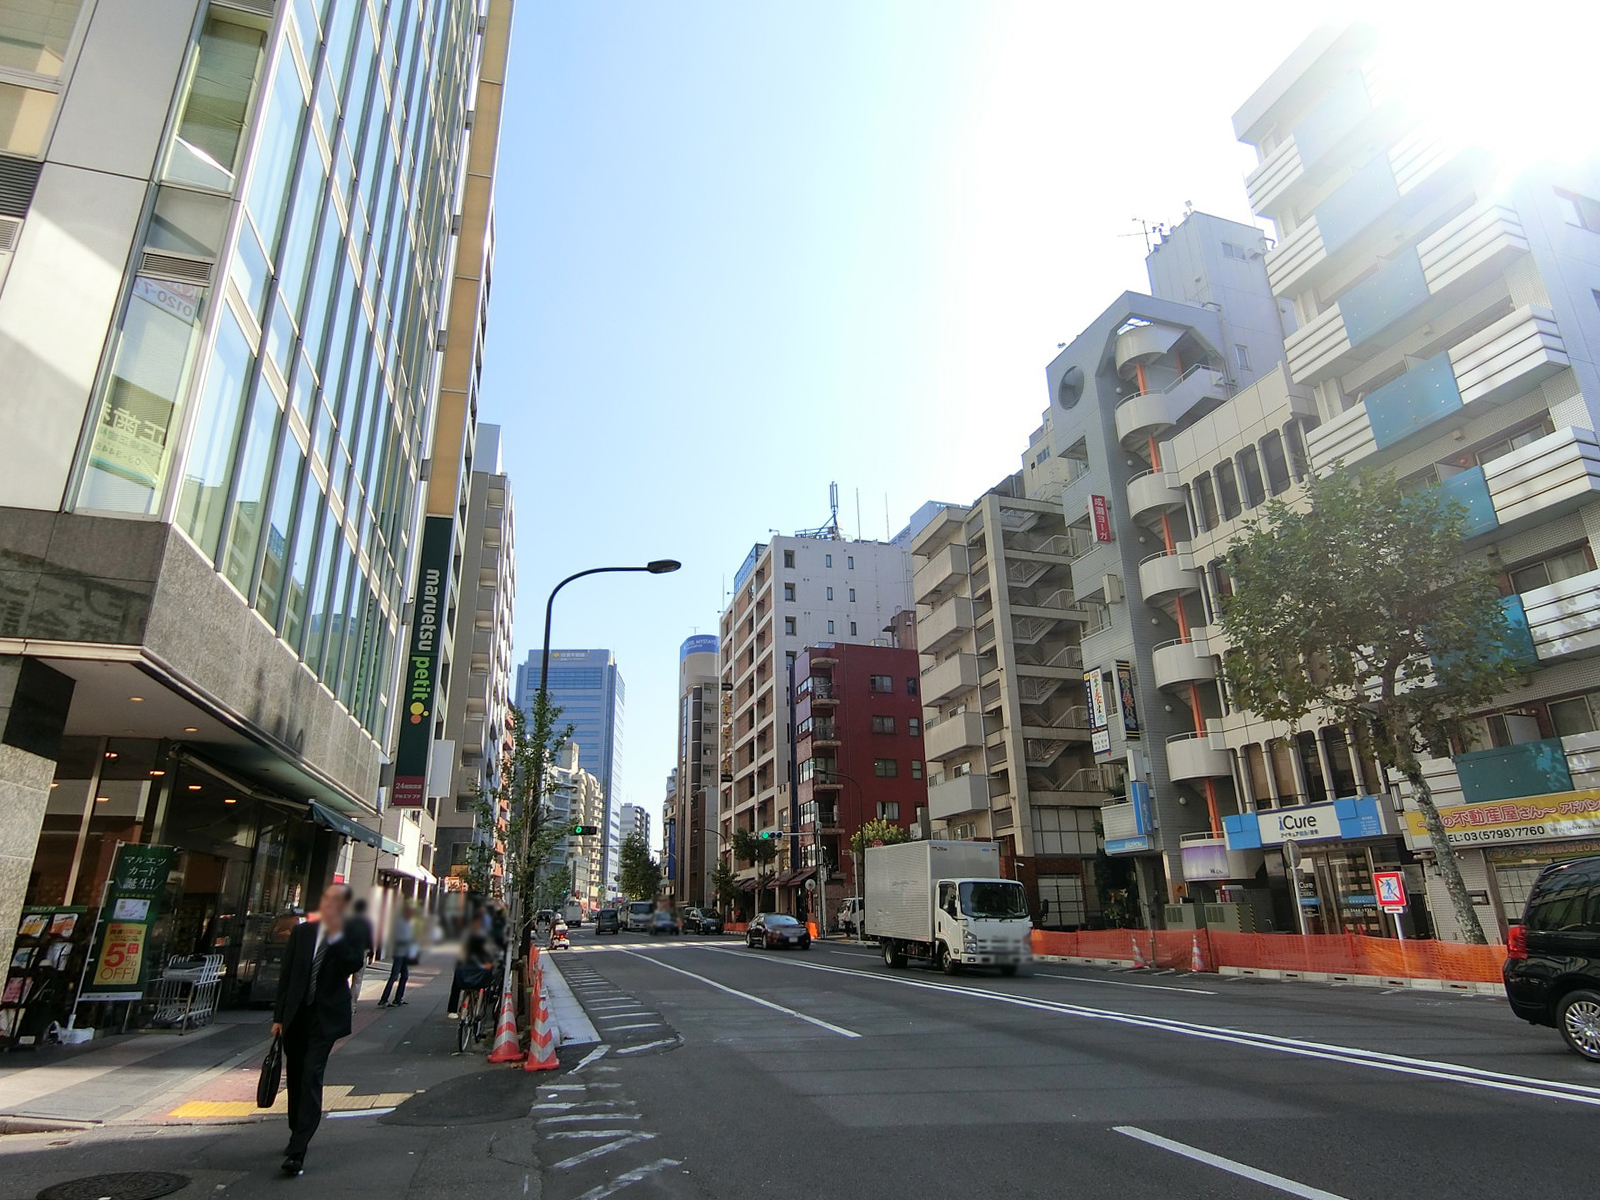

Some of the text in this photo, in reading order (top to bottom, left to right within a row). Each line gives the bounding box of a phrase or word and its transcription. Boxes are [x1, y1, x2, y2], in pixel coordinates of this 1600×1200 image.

[411, 569, 441, 700] maruetsu petit
[1278, 815, 1317, 830] iCure
[1449, 825, 1545, 843] EL:03(5798)7760
[124, 855, 167, 867] マルエツ
[127, 866, 159, 877] カード
[122, 877, 156, 890] 誕生!
[1298, 881, 1313, 889] Cure
[103, 943, 137, 968] 5%
[100, 967, 136, 980] OFF!
